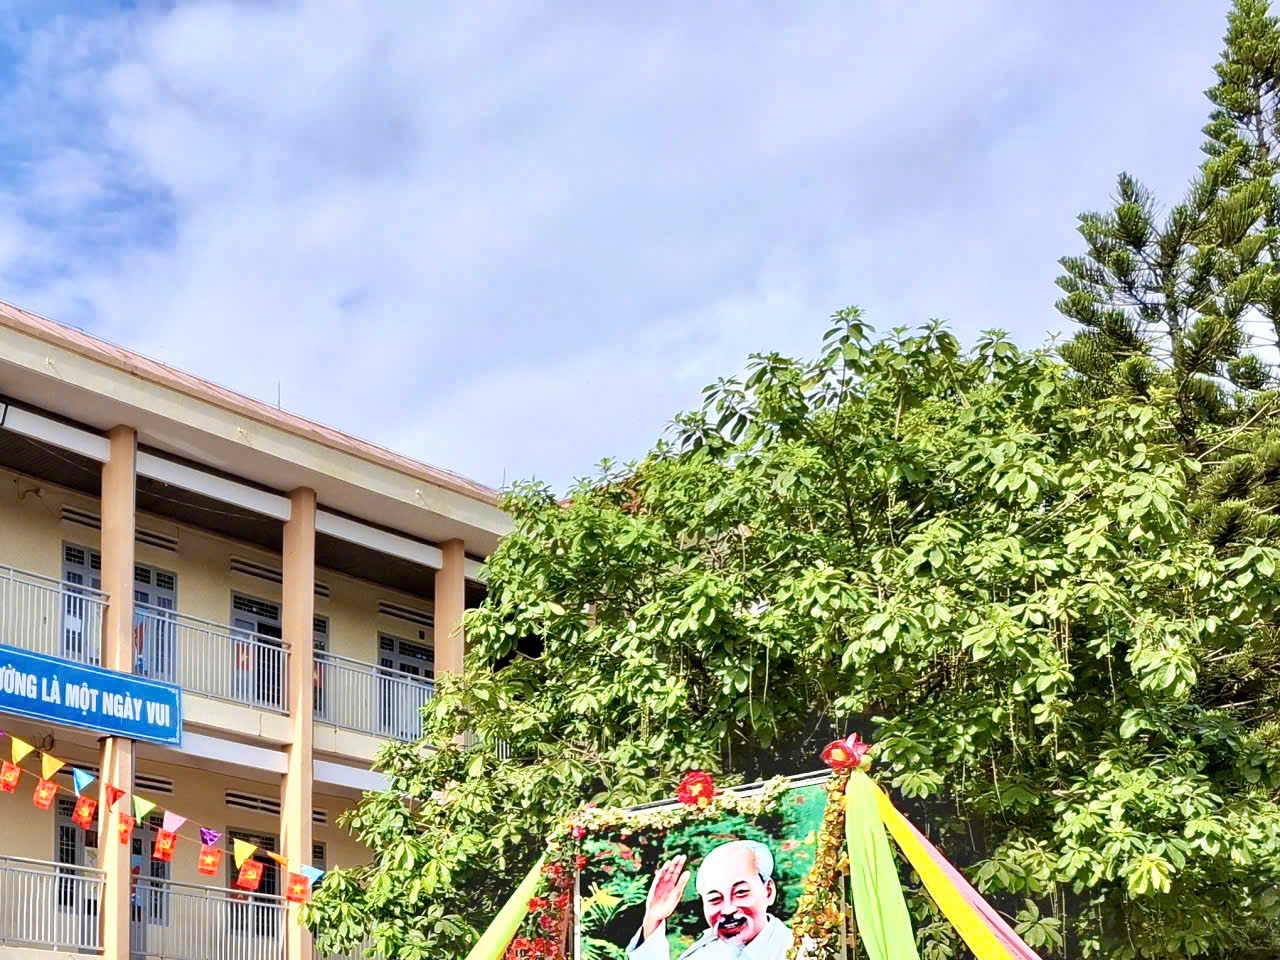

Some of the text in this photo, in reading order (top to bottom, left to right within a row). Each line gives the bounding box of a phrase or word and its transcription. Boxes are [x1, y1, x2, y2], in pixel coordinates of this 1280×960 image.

[42, 676, 61, 704] LÀ
[65, 683, 99, 716] MỘT
[102, 691, 143, 722] NGÀY
[146, 702, 170, 727] VUI
